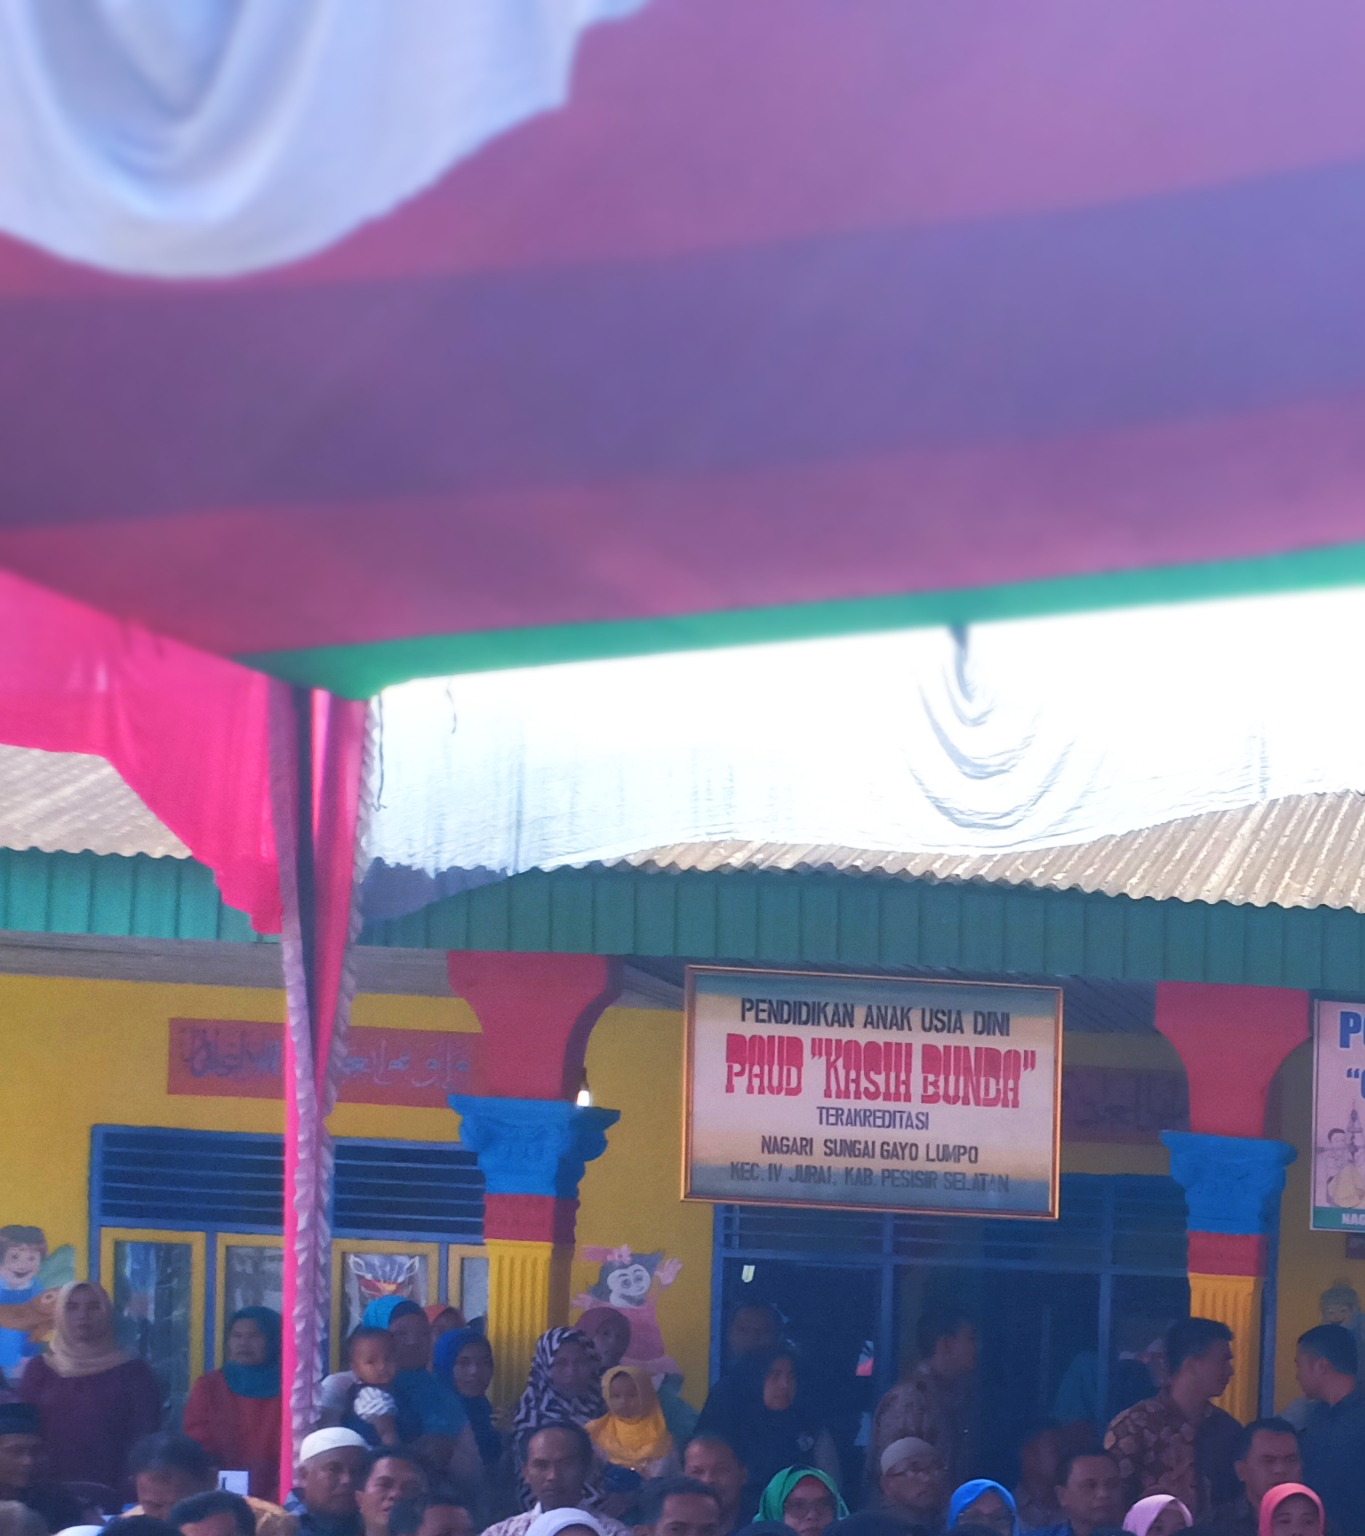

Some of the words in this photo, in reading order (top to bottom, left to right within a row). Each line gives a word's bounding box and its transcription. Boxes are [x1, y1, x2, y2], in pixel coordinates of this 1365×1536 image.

[741, 998, 854, 1028] PENDIDIKAN
[863, 1005, 913, 1031] ANAK
[921, 1008, 964, 1034] USIA
[973, 1011, 1010, 1036] DINI
[725, 1033, 803, 1096] PAUD
[811, 1037, 913, 1103] "KASIH
[921, 1044, 1036, 1108] BUNDA"
[816, 1106, 929, 1130] TERAKREDITASI
[761, 1135, 813, 1156] NAGARI
[823, 1138, 875, 1159] SUNGAI
[880, 1141, 919, 1161] GAYO
[926, 1144, 979, 1164] LUMPO
[731, 1161, 764, 1181] KEC.
[768, 1163, 782, 1182] IV
[845, 1166, 876, 1186] KAB.
[881, 1169, 938, 1189] PESISIR
[943, 1171, 1009, 1192] SELATAN
